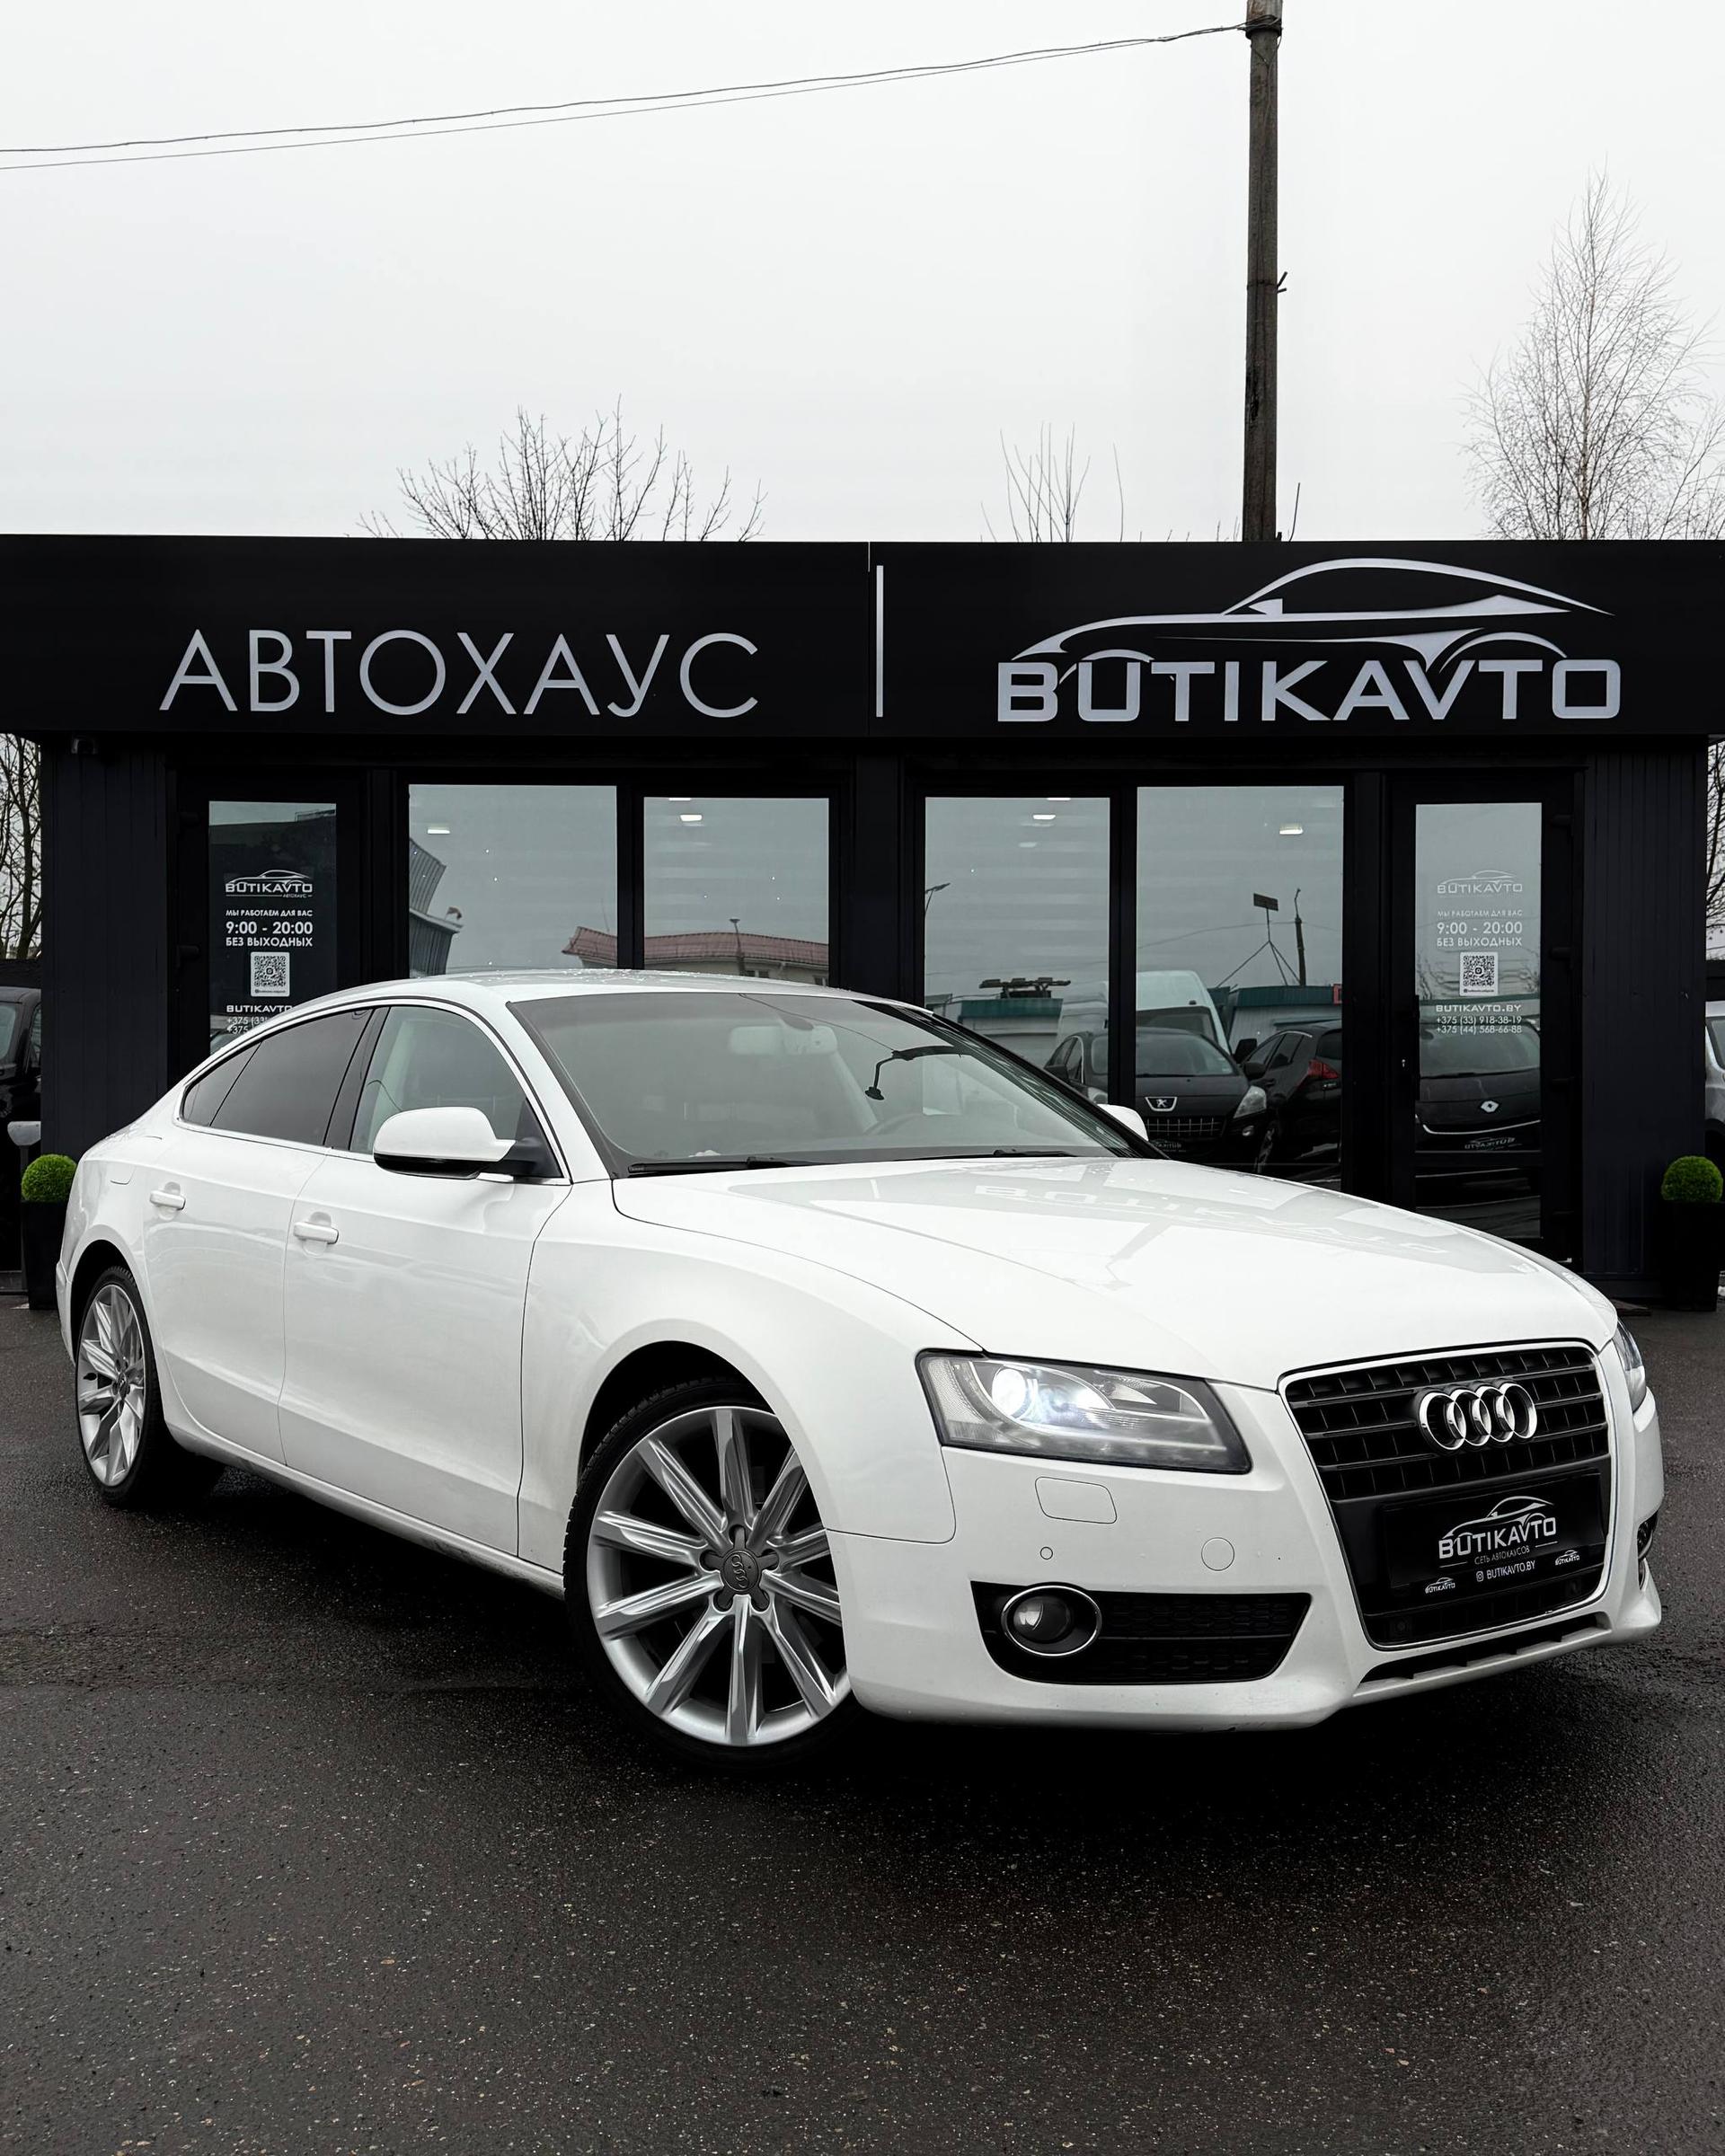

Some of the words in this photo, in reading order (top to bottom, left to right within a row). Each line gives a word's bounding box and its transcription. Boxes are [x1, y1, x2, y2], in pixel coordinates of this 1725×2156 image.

[158, 628, 760, 719] АВТОХАУС
[997, 658, 1622, 723] BUTIKAVTO
[226, 883, 313, 893] BUTIKAVTO
[1438, 883, 1523, 894] BUTIKAVTO
[226, 921, 258, 934] 9:00
[272, 921, 313, 934] 20:00
[1437, 922, 1467, 934] 9:00
[1482, 921, 1523, 934] 20:00
[226, 937, 244, 947] БЕЗ
[247, 937, 313, 948] ВЫХОДНЫХ
[1437, 937, 1455, 947] БЕЗ
[1457, 937, 1522, 947] ВЫХОДНЫХ
[1436, 1004, 1521, 1012] BUTIKAVTO.BY
[226, 1016, 249, 1025] +375
[1437, 1015, 1457, 1024] +375
[1460, 1015, 1476, 1026] (33)
[1479, 1015, 1522, 1024] 918-38-19
[1437, 1025, 1457, 1034] +375
[1460, 1025, 1476, 1035] (44)
[1479, 1025, 1522, 1034] 568-66-88
[1438, 1516, 1557, 1560] BUTIKAVTO
[1486, 1560, 1535, 1580] BUTIKAVTO.BY
